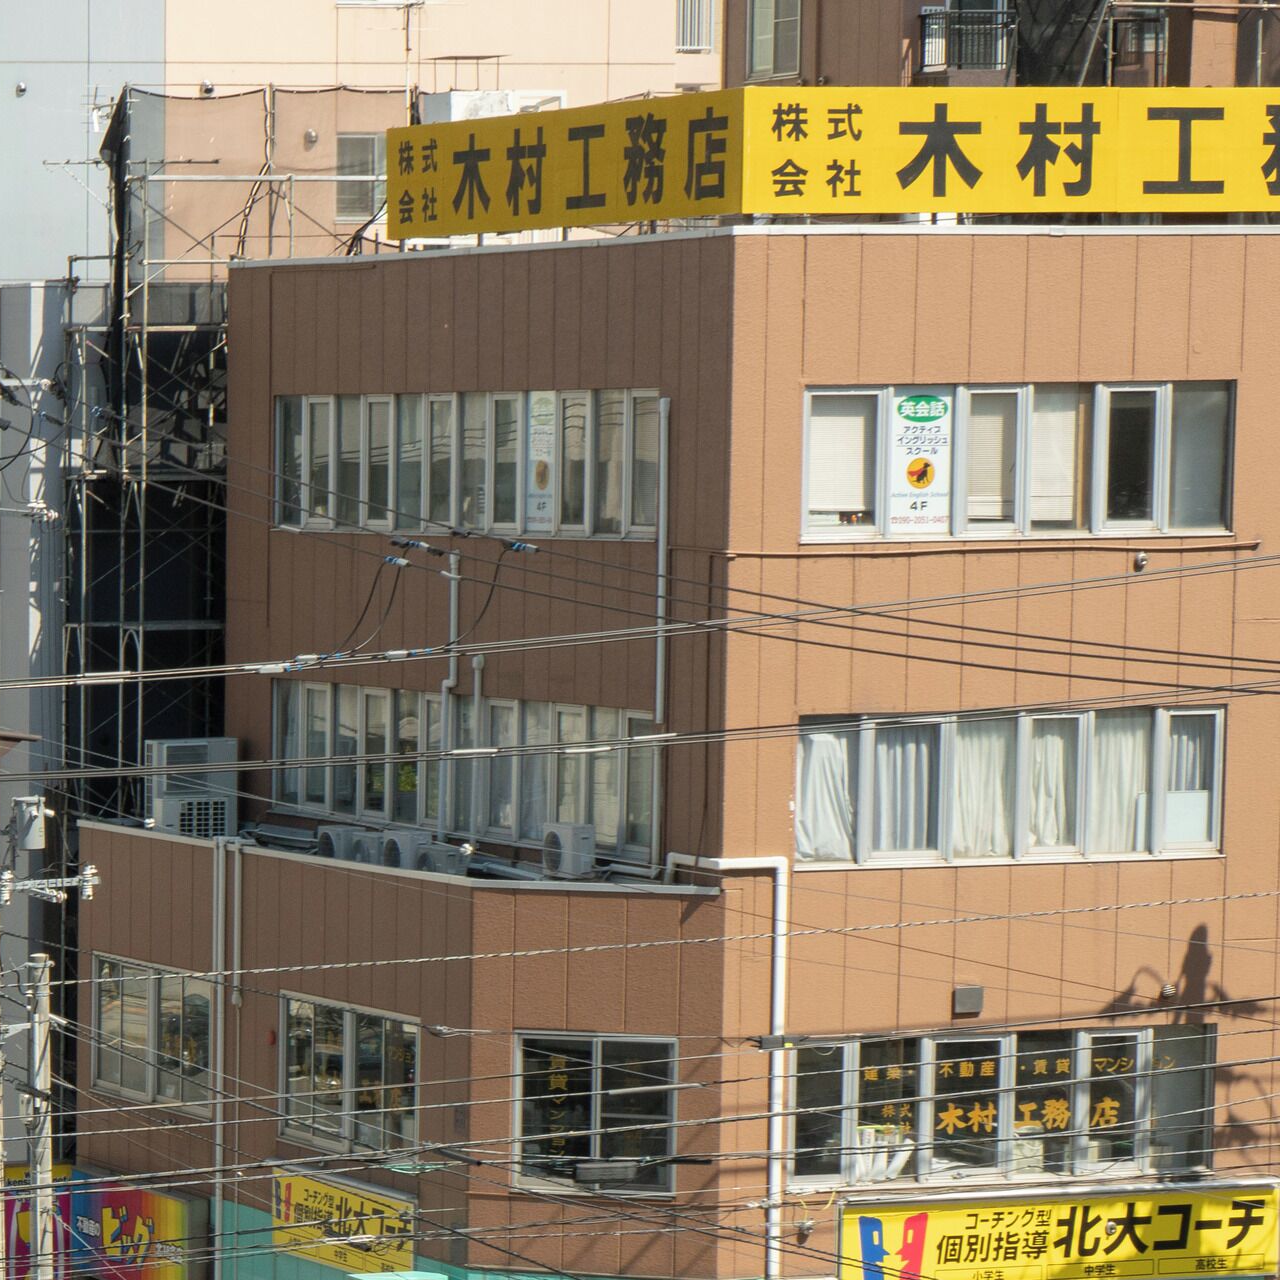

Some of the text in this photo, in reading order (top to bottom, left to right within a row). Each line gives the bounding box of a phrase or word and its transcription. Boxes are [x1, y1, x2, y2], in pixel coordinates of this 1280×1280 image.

[771, 103, 863, 142] 株式
[398, 139, 438, 176] 株式
[453, 107, 729, 220] 木村工務店
[896, 102, 1280, 197] 木村工
[771, 159, 862, 198] 会社
[398, 189, 438, 224] 会社
[900, 401, 946, 418] 英会話
[906, 447, 938, 456] スクール
[910, 501, 928, 511] 4F
[936, 1097, 1121, 1135] 木村工務店
[101, 1205, 156, 1270] ビッグ
[965, 1209, 1052, 1230] コーチング型
[1053, 1199, 1266, 1258] 北大コーチ
[936, 1230, 1050, 1265] 個別指導
[1195, 1257, 1228, 1271] 高校生
[1083, 1264, 1116, 1277] 中学生
